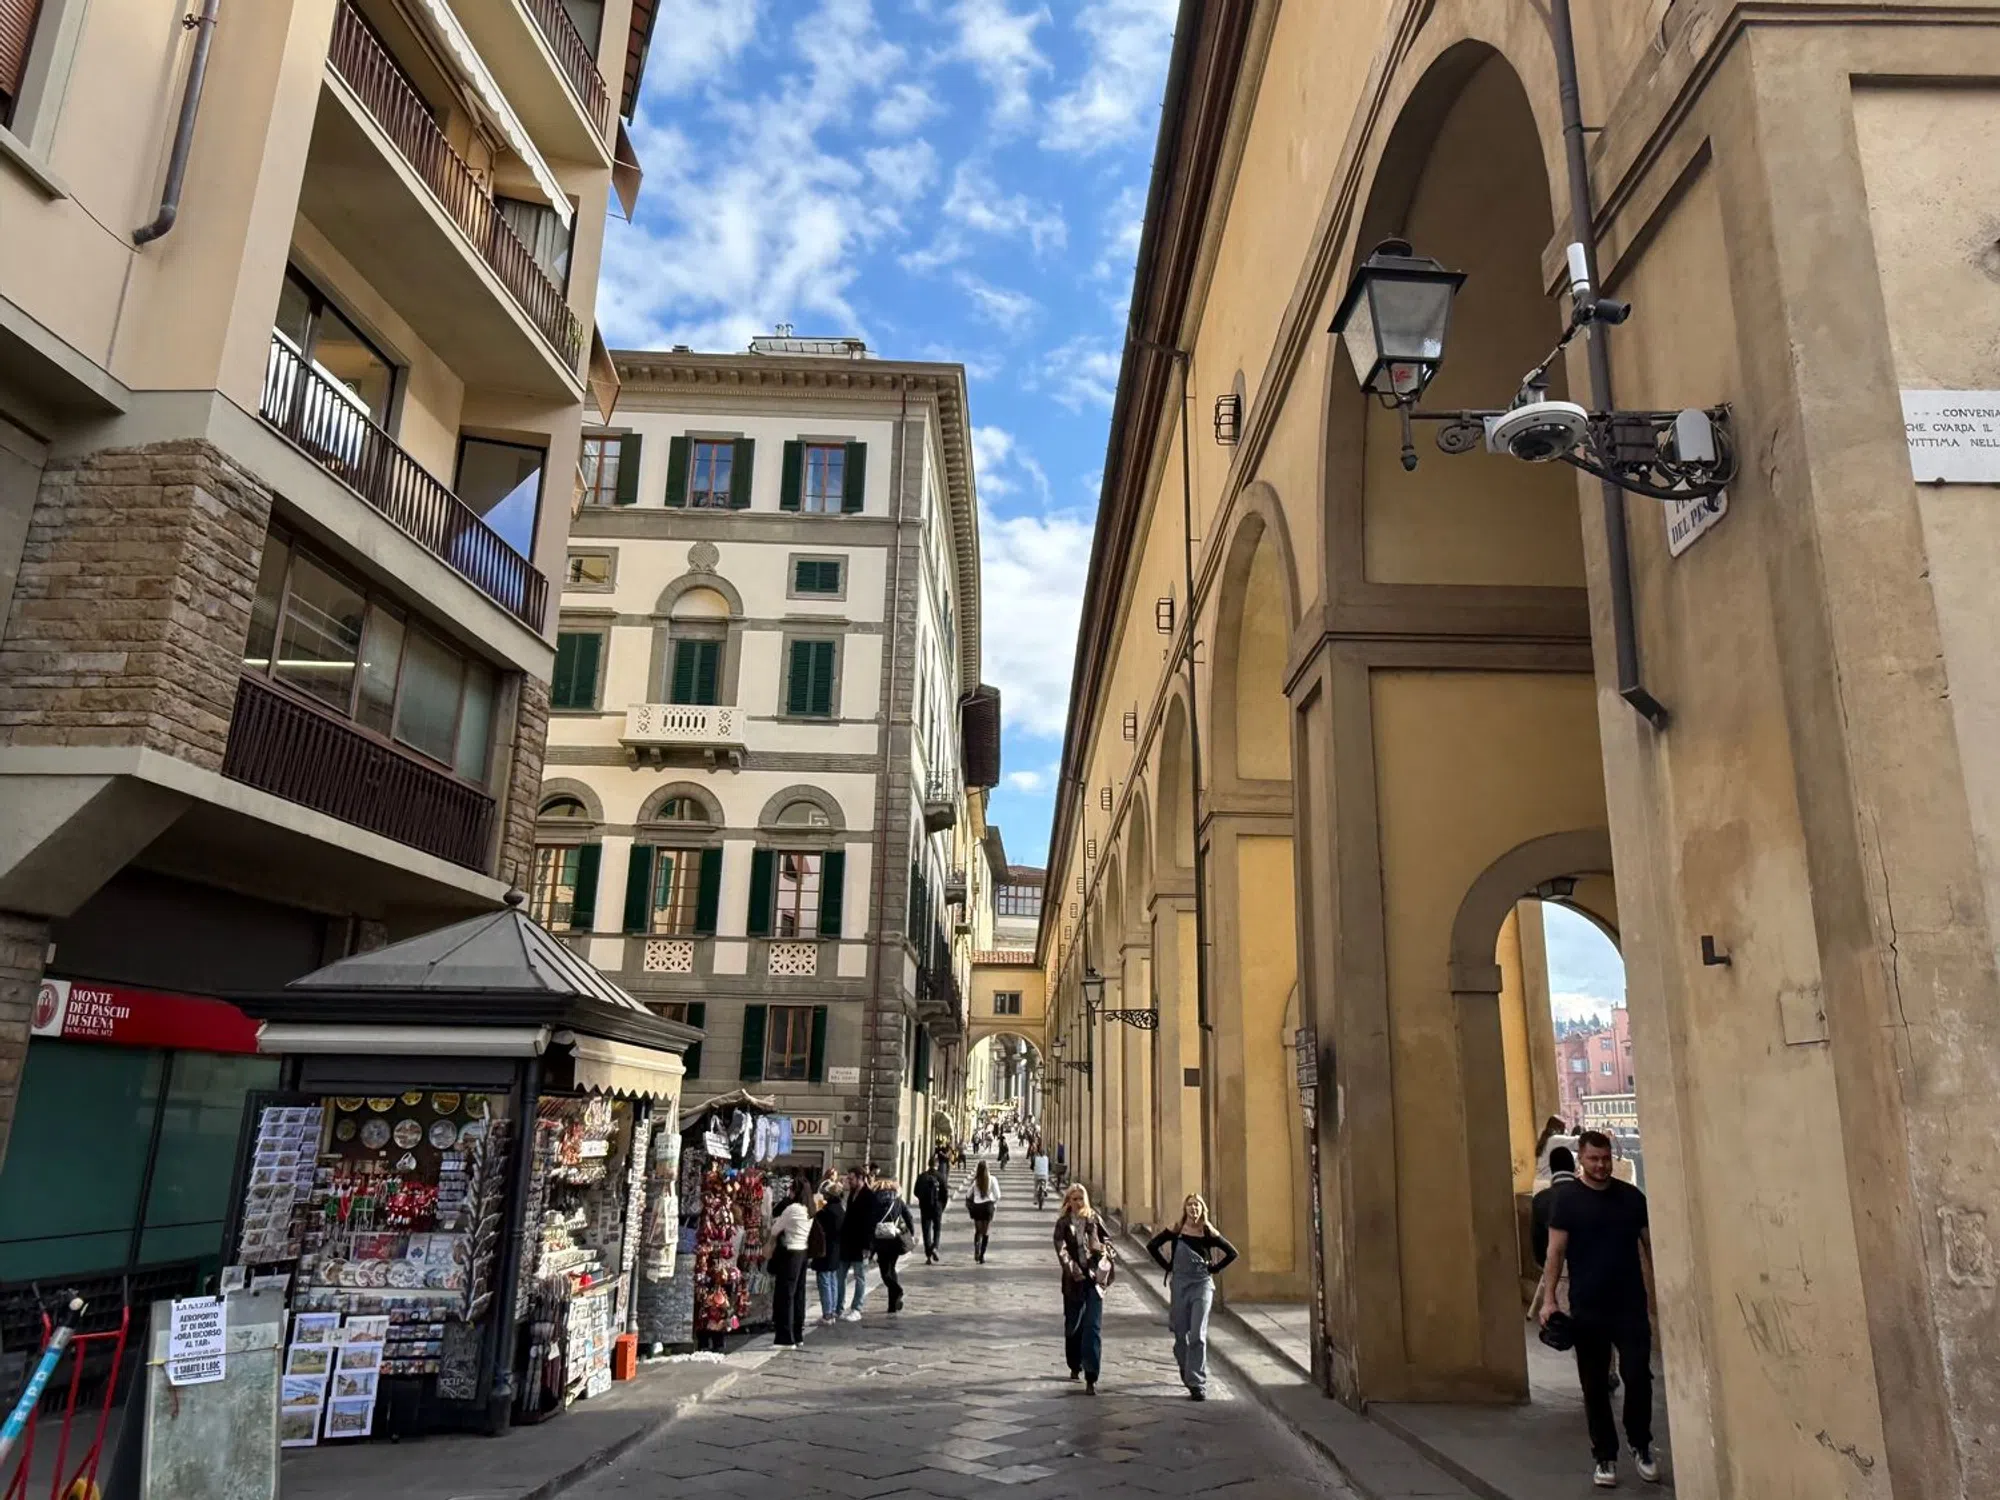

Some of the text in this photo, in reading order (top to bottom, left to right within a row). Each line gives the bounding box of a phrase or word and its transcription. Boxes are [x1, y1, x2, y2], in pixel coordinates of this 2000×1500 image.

[1905, 423, 1993, 434] CHE GVARDA IL
[1908, 438, 2000, 448] VITTIMA NELL
[1672, 518, 1690, 544] DEL
[71, 989, 114, 1005] MONTE
[69, 1001, 131, 1019] DEI PASCHI
[66, 1013, 114, 1029] DI SIENA
[179, 1312, 219, 1323] AEROPORTO
[190, 1323, 197, 1331] DI
[198, 1320, 217, 1329] ROMA
[193, 1329, 222, 1339] RICORSO
[184, 1340, 193, 1348] AL
